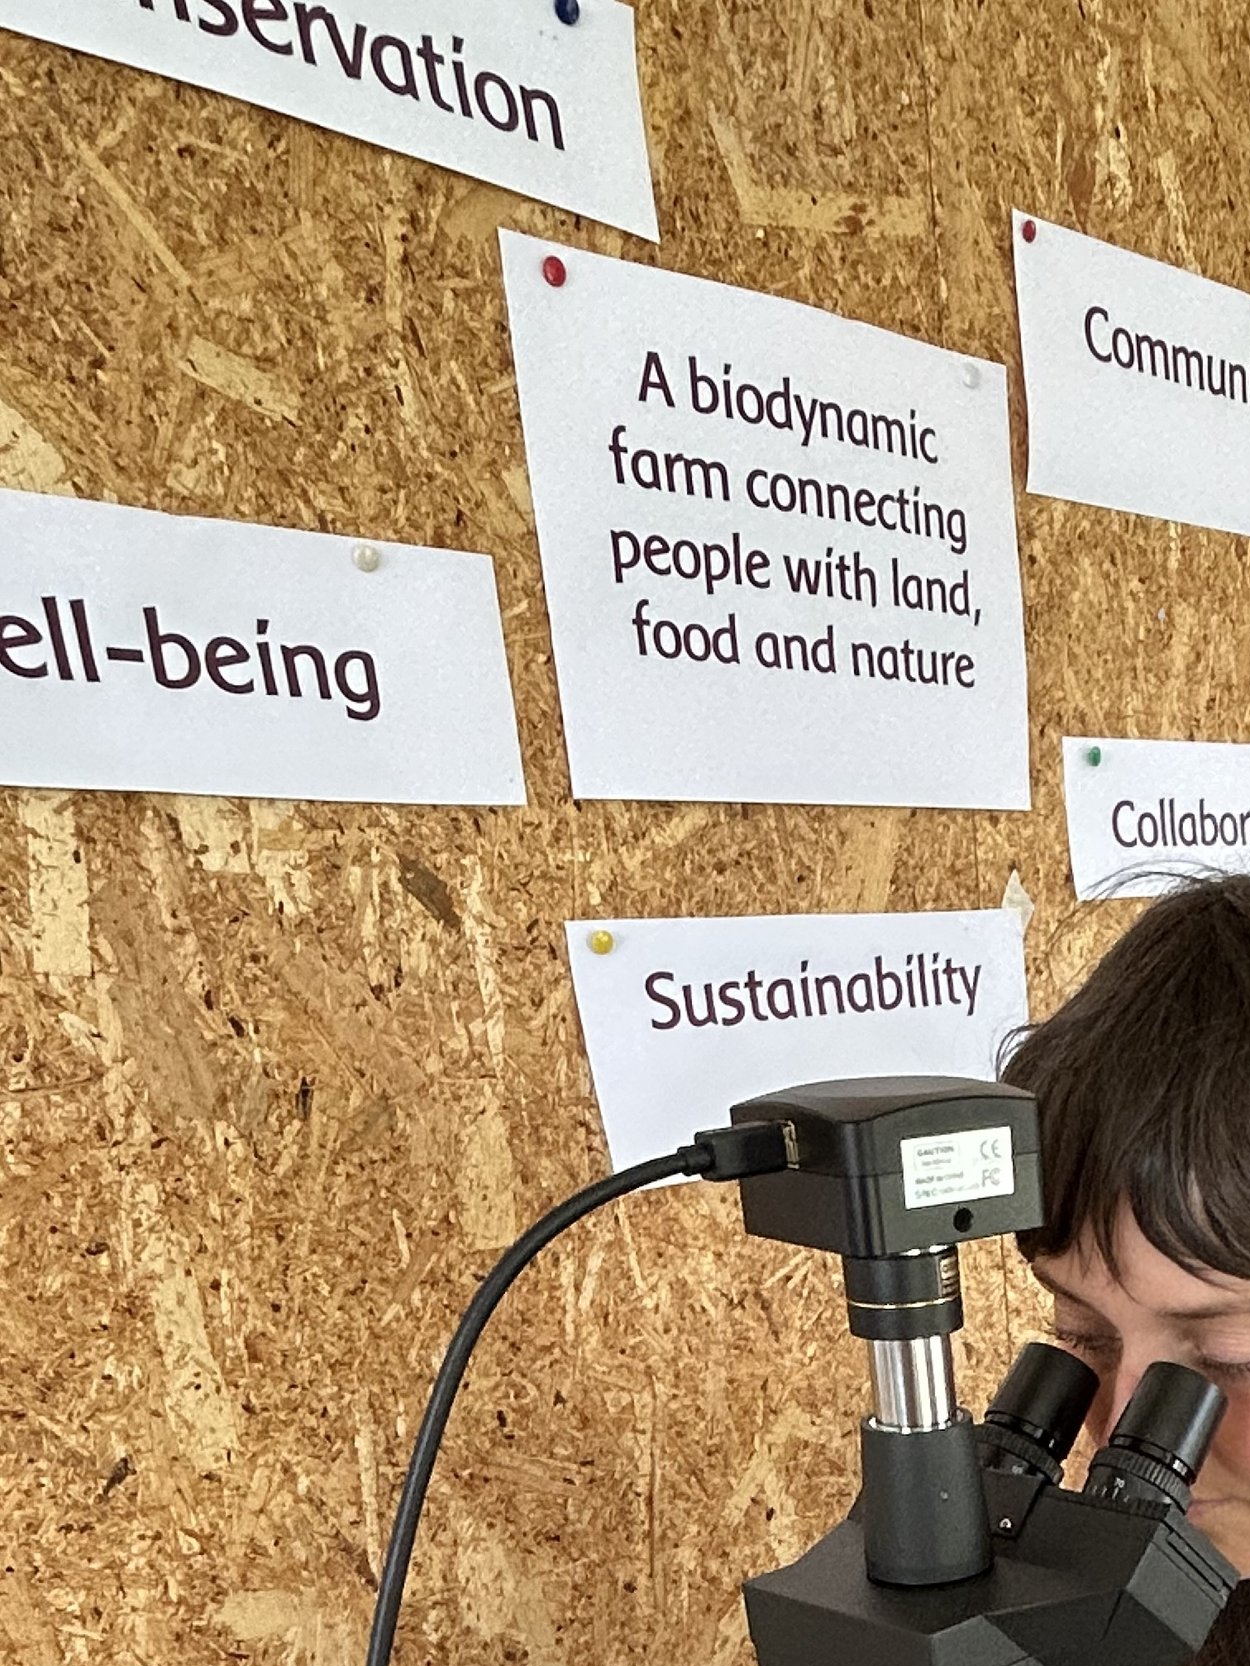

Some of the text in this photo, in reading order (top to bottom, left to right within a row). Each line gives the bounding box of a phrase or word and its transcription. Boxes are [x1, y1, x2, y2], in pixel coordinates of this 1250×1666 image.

[138, 0, 565, 151] servation
[638, 351, 938, 464] A biodynamic
[608, 425, 967, 555] farm connecting
[610, 529, 981, 626] people with land,
[0, 596, 381, 721] ell-being
[632, 599, 975, 688] food and nature
[644, 952, 982, 1030] Sustainability
